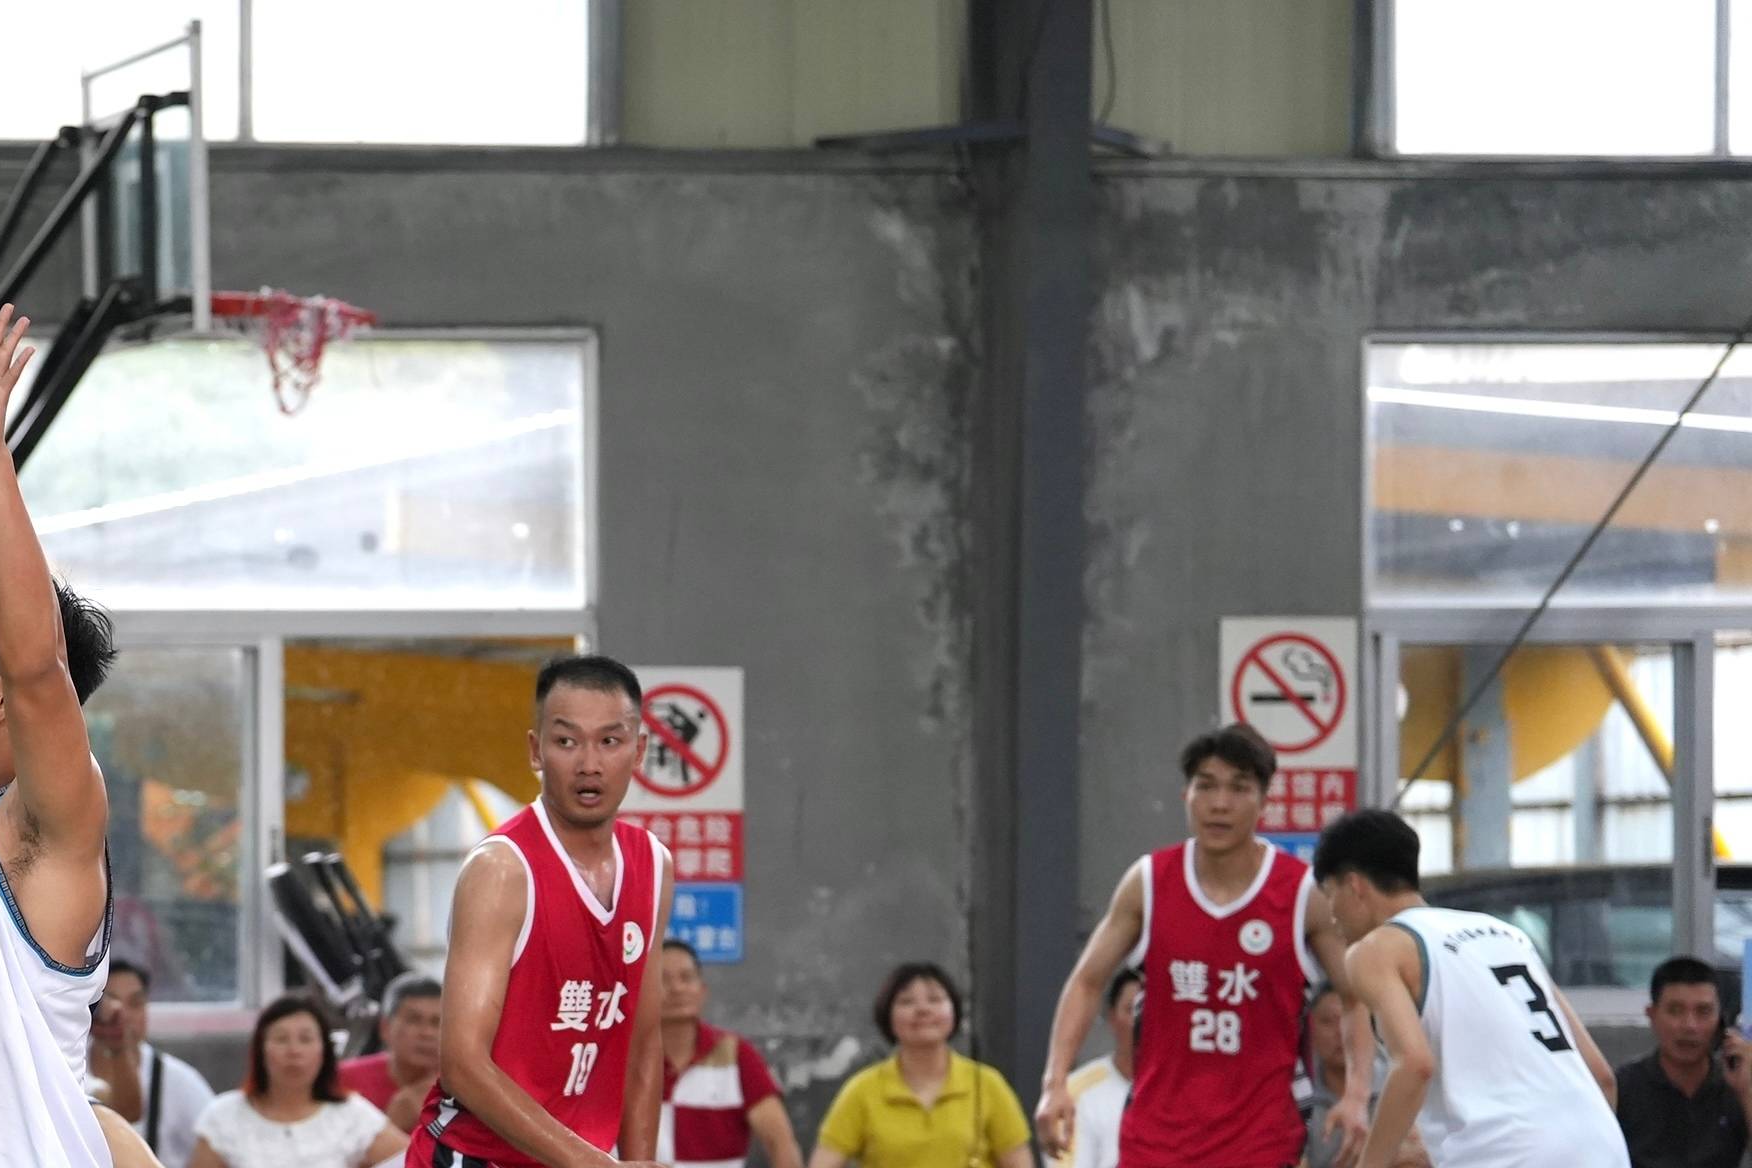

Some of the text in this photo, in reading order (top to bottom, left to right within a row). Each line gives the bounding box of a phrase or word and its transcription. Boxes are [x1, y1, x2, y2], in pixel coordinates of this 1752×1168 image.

[550, 979, 628, 1032] 雙水
[1169, 960, 1261, 1005] 雙水
[1490, 964, 1573, 1052] 3
[1190, 1008, 1242, 1055] 28
[563, 1042, 599, 1097] 10
